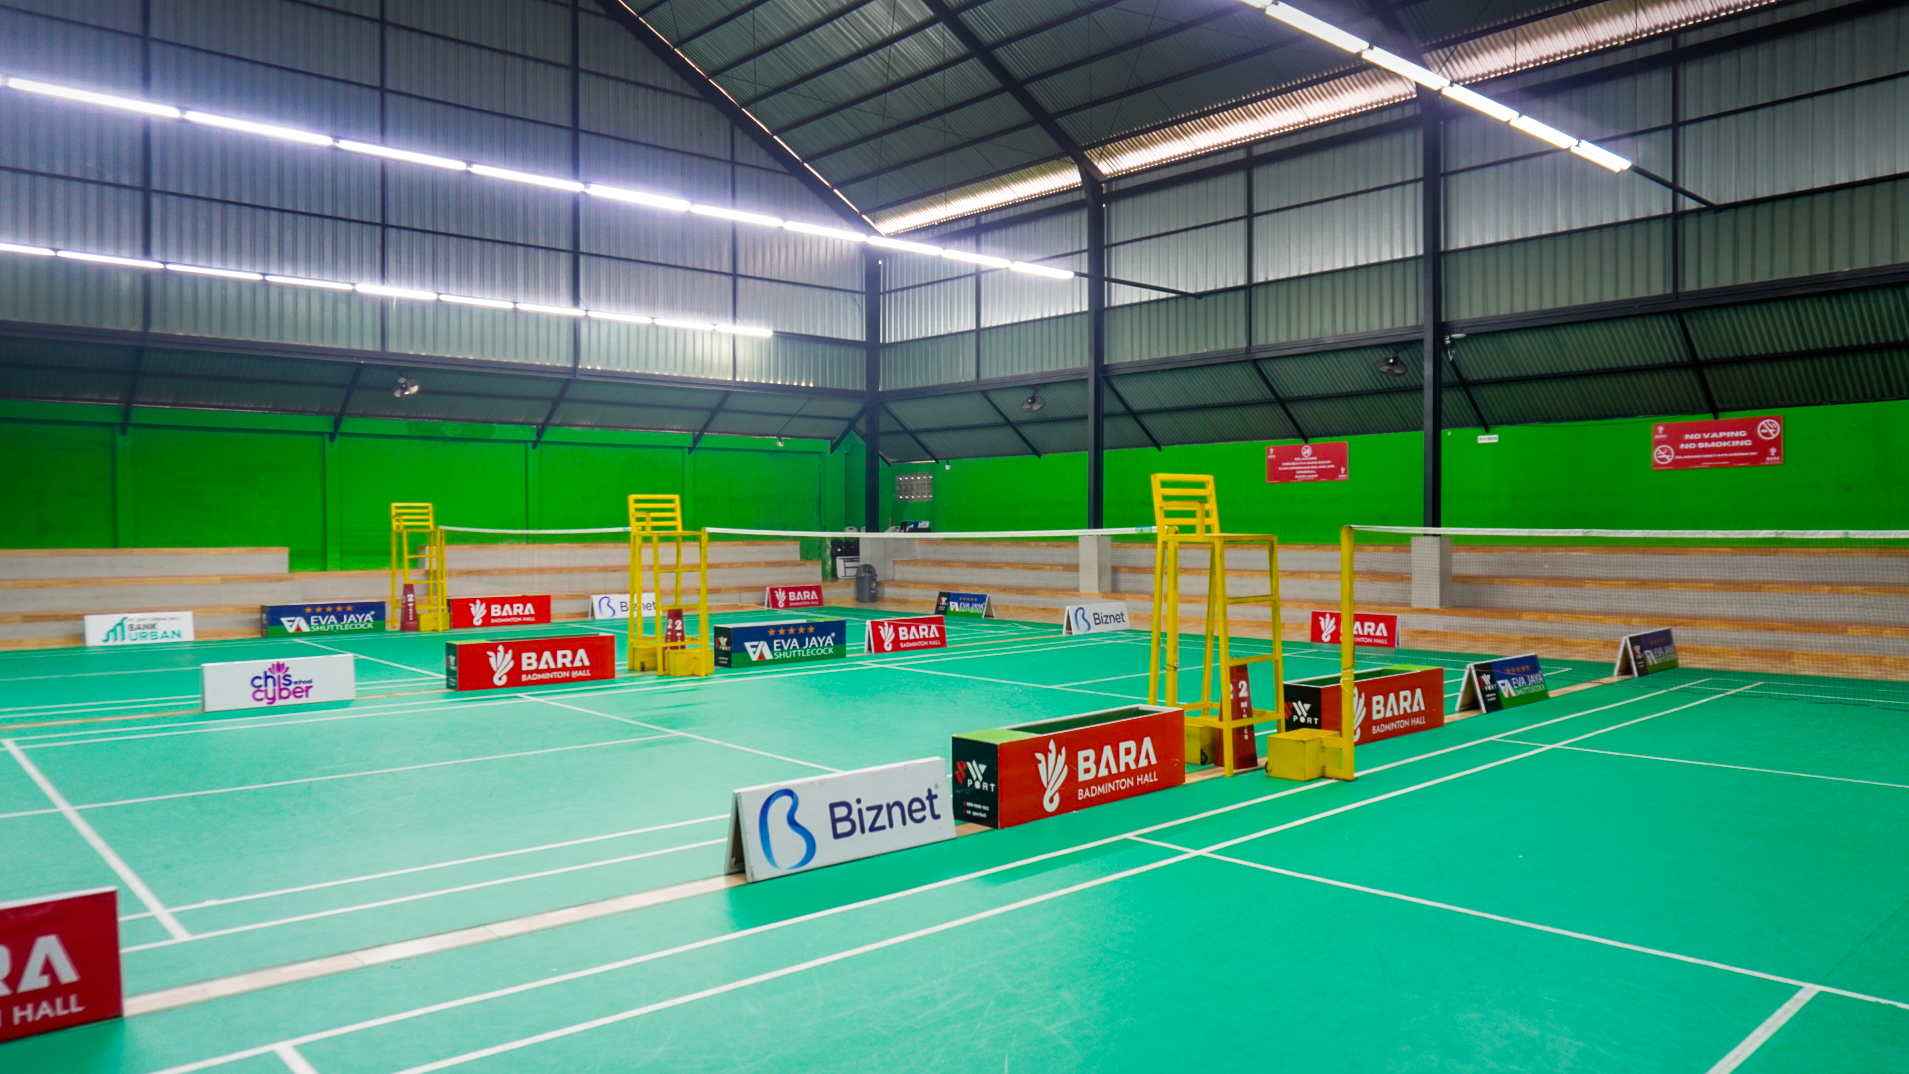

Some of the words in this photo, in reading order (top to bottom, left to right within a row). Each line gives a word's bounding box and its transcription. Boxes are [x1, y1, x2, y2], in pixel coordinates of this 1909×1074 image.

[1702, 430, 1747, 438] VAPING
[1698, 440, 1752, 448] SMOKING
[789, 590, 818, 601] BARA
[490, 603, 536, 616] BARA
[620, 601, 656, 612] Bznet
[311, 615, 338, 625] EVA
[341, 614, 374, 624] JAYA
[675, 620, 682, 630] 2
[1092, 611, 1126, 626] Biznet
[128, 623, 157, 631] BANK
[311, 623, 374, 632] SHUTTLECOCK
[898, 625, 940, 640] BARA
[1340, 621, 1388, 637] ARA
[128, 630, 182, 641] URBAN
[774, 638, 800, 651] EVA
[803, 636, 834, 649] JAYA
[521, 648, 590, 671] BARA
[774, 647, 834, 659] SHUTTLECOCK
[521, 671, 570, 682] BADMINTON
[571, 669, 591, 678] HALL
[1512, 676, 1527, 688] EVA
[1528, 673, 1544, 685] JAYA
[252, 685, 314, 705] cyber
[1238, 680, 1248, 698] 2
[1372, 688, 1426, 720] BARA
[1293, 715, 1318, 725] PORT
[1372, 719, 1410, 735] BADMINTON
[1410, 716, 1426, 726] HALL
[1077, 736, 1158, 782] BARA
[967, 779, 996, 792] PORT
[1077, 776, 1134, 800] BADMINTON
[1136, 771, 1158, 786] HALL
[829, 788, 941, 840] Biznet
[12, 994, 86, 1026] HALL
